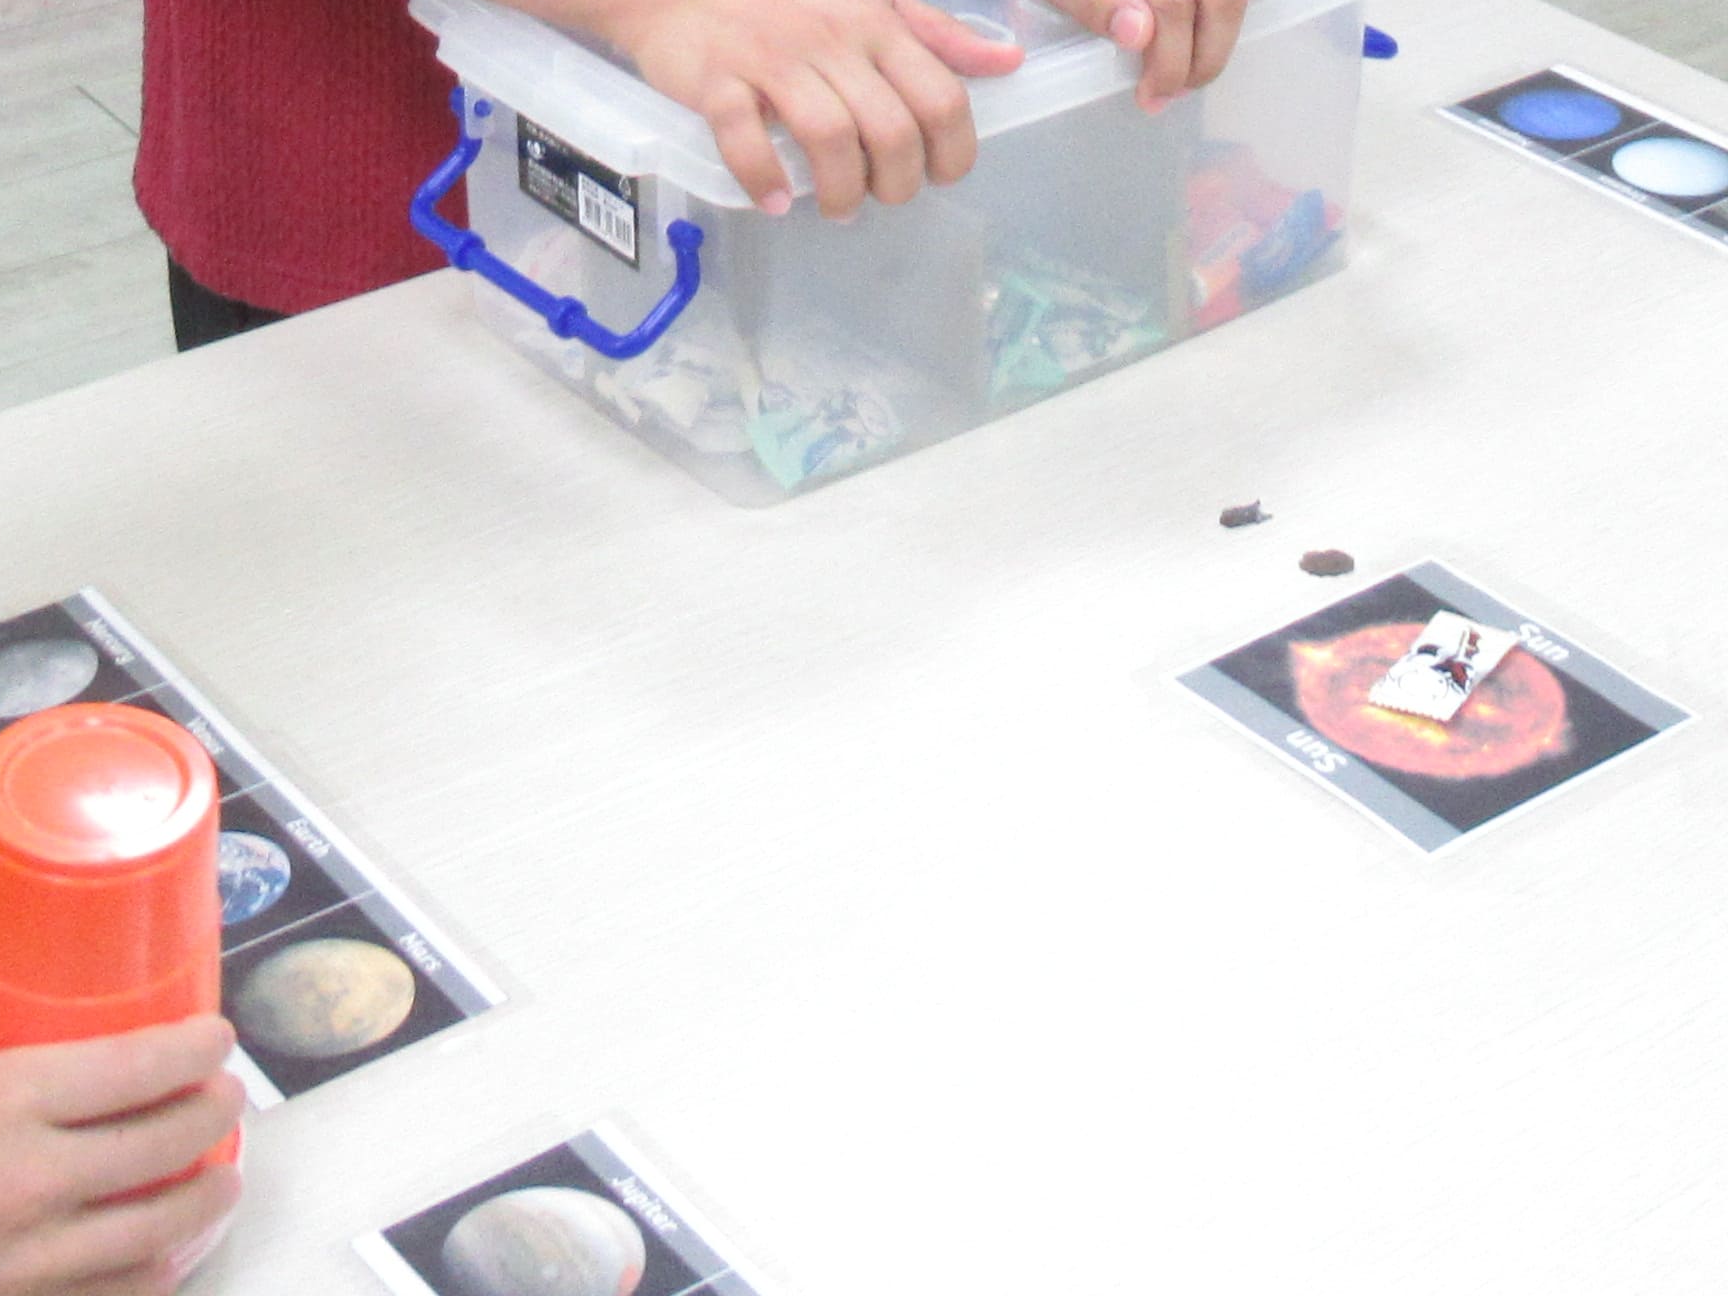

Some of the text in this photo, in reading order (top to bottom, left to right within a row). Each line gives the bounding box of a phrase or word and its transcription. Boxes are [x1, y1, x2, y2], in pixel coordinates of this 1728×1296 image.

[1516, 623, 1569, 662] Sun
[1285, 729, 1347, 775] Sun
[399, 932, 441, 976] Mars
